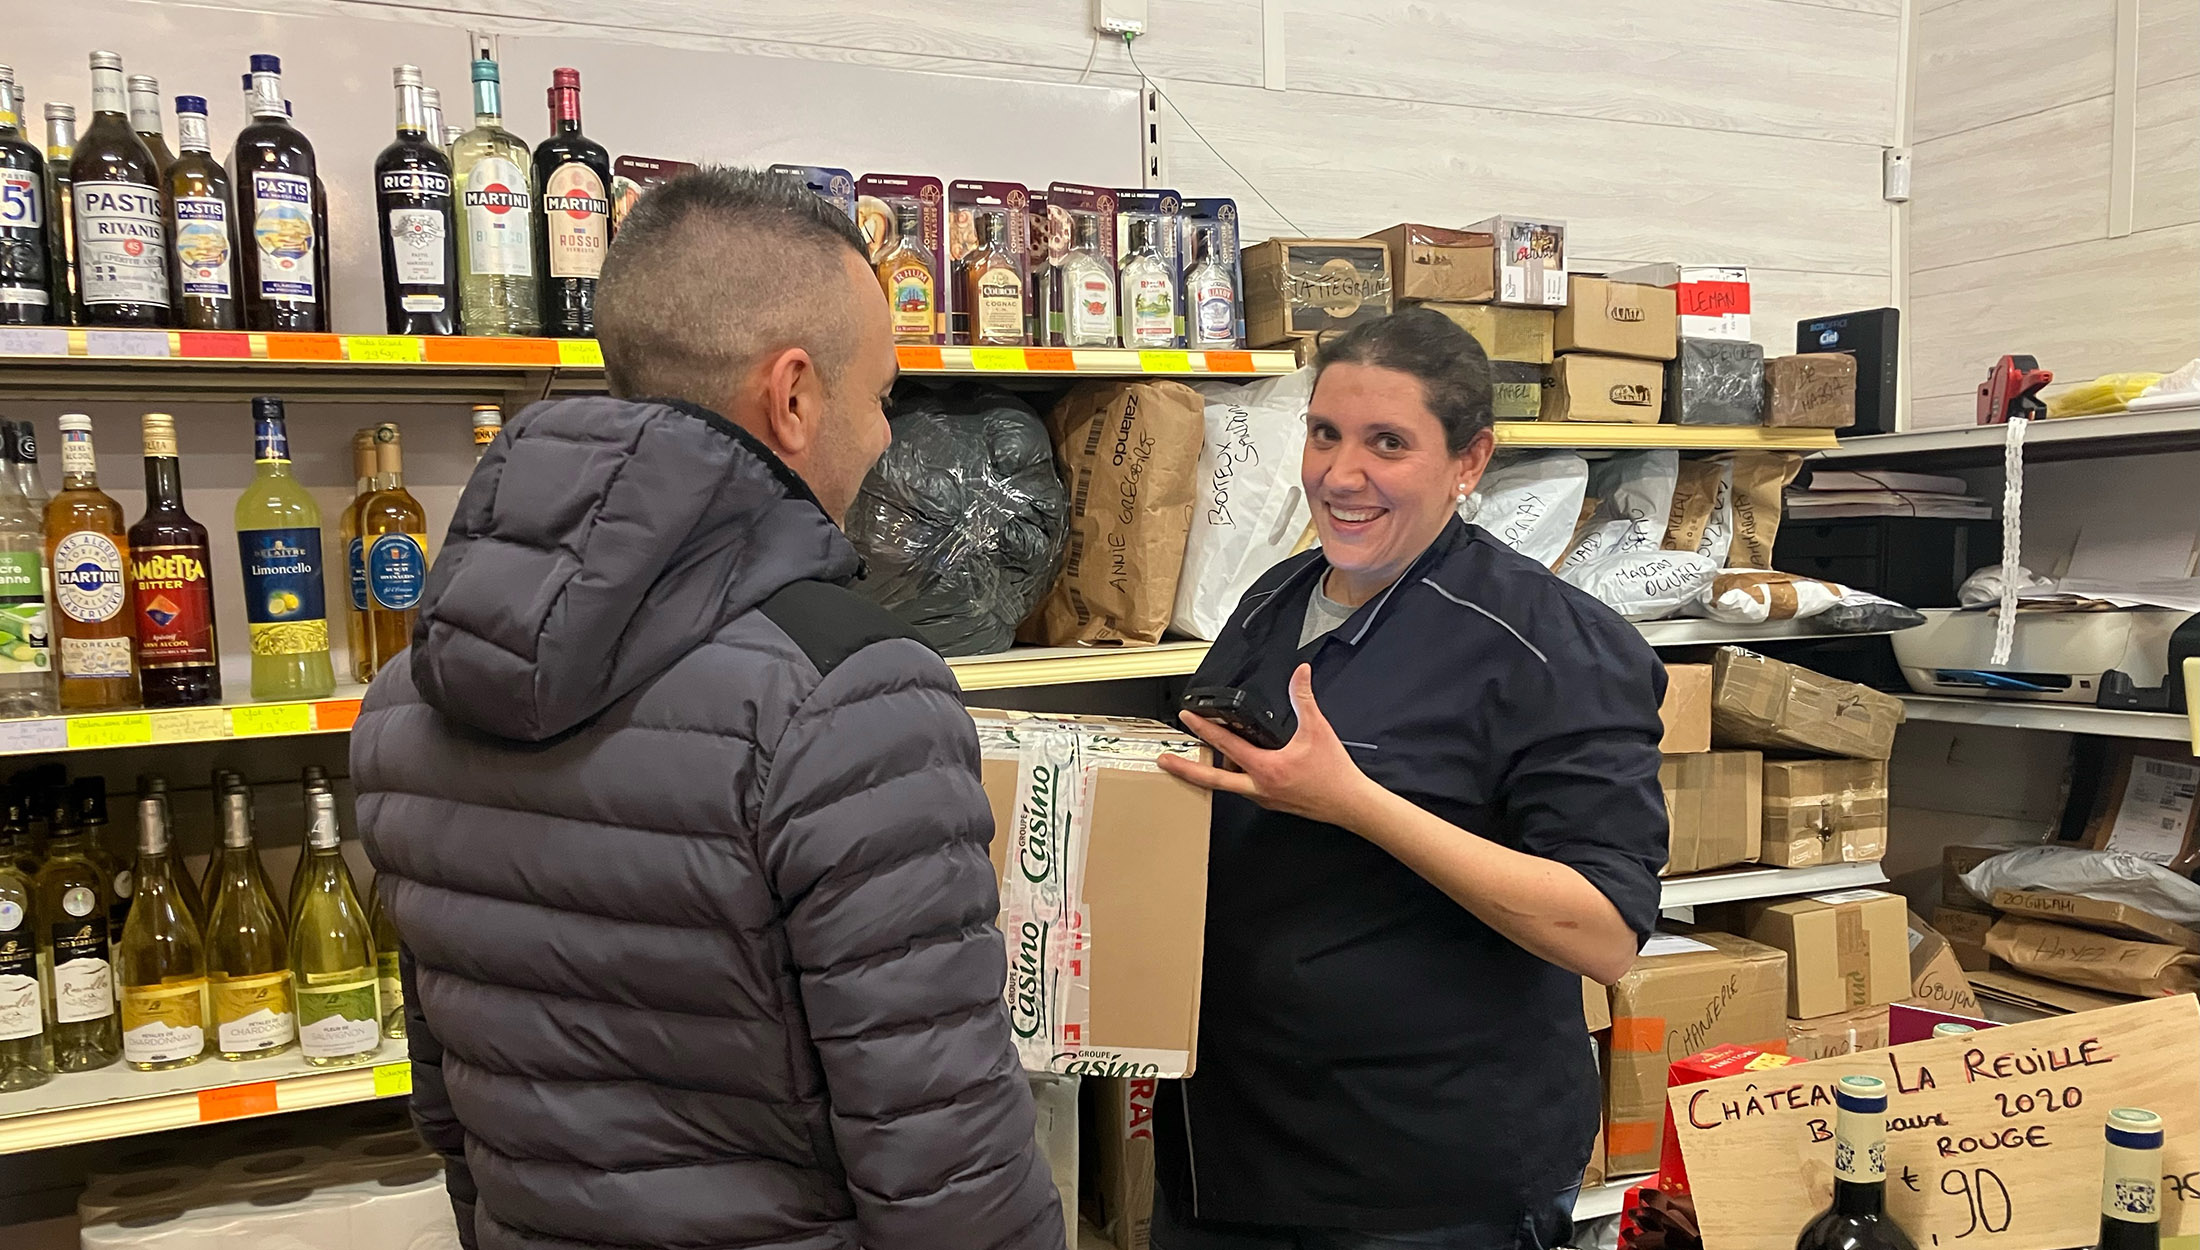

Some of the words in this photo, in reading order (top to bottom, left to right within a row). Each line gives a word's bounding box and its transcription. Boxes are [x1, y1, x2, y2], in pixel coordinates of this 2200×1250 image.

[258, 180, 308, 196] PASTIS
[384, 175, 446, 190] RICARD
[2, 186, 37, 223] 51
[85, 193, 162, 218] PASTIS
[466, 191, 528, 208] MARTINI
[548, 197, 607, 214] MARTINI
[178, 203, 222, 215] PASTIS
[98, 222, 161, 240] RIVANIS
[559, 234, 600, 248] ROSSO
[895, 268, 927, 283] RHUM
[1688, 285, 1735, 313] LEMAN
[1819, 330, 1838, 344] Ciel
[1113, 394, 1139, 467] zalando
[1207, 441, 1236, 530] BOITEUX
[0, 565, 22, 573] cre
[251, 562, 312, 576] Limoncello
[1108, 532, 1128, 594] ANNIE
[59, 571, 119, 584] MARTINI
[138, 580, 183, 590] BITTER
[1019, 814, 1027, 847] GROUPE
[1020, 765, 1051, 884] Casino
[1008, 970, 1017, 1005] GROUPE
[1010, 921, 1041, 1039] Casino
[1918, 971, 1978, 1010] GOUJON
[1666, 973, 1740, 1064] CHANTEPIE
[128, 1033, 193, 1047] CHARDONNAY
[312, 1028, 366, 1041] SAUVIGNON
[1078, 1050, 1111, 1060] GROUPE
[1888, 1052, 1937, 1094] LA
[1994, 1086, 2083, 1118] 2020
[1936, 1125, 2052, 1157] ROUGE
